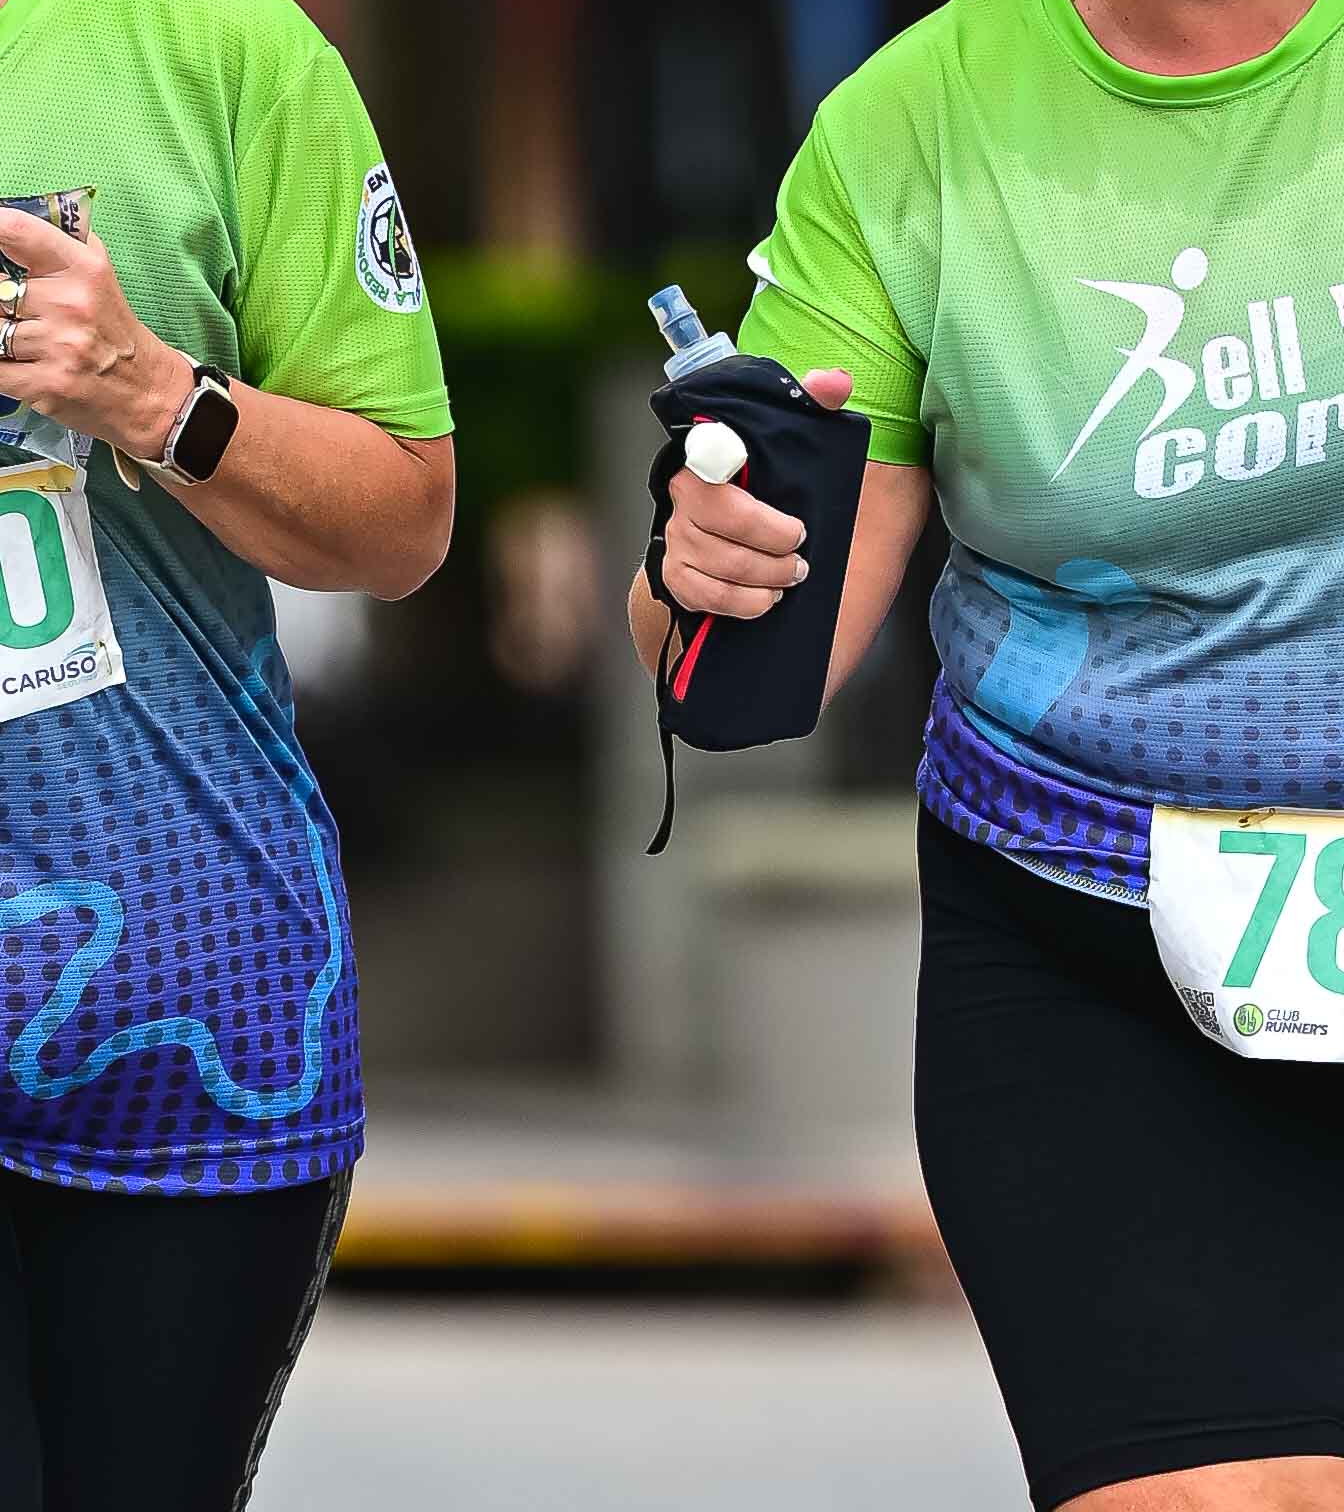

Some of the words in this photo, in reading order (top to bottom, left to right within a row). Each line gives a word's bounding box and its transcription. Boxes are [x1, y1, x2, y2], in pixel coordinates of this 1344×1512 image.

[2, 656, 96, 695] CARUSO
[1267, 1009, 1299, 1022] CLUB
[1265, 1021, 1329, 1036] RUNNER'S
